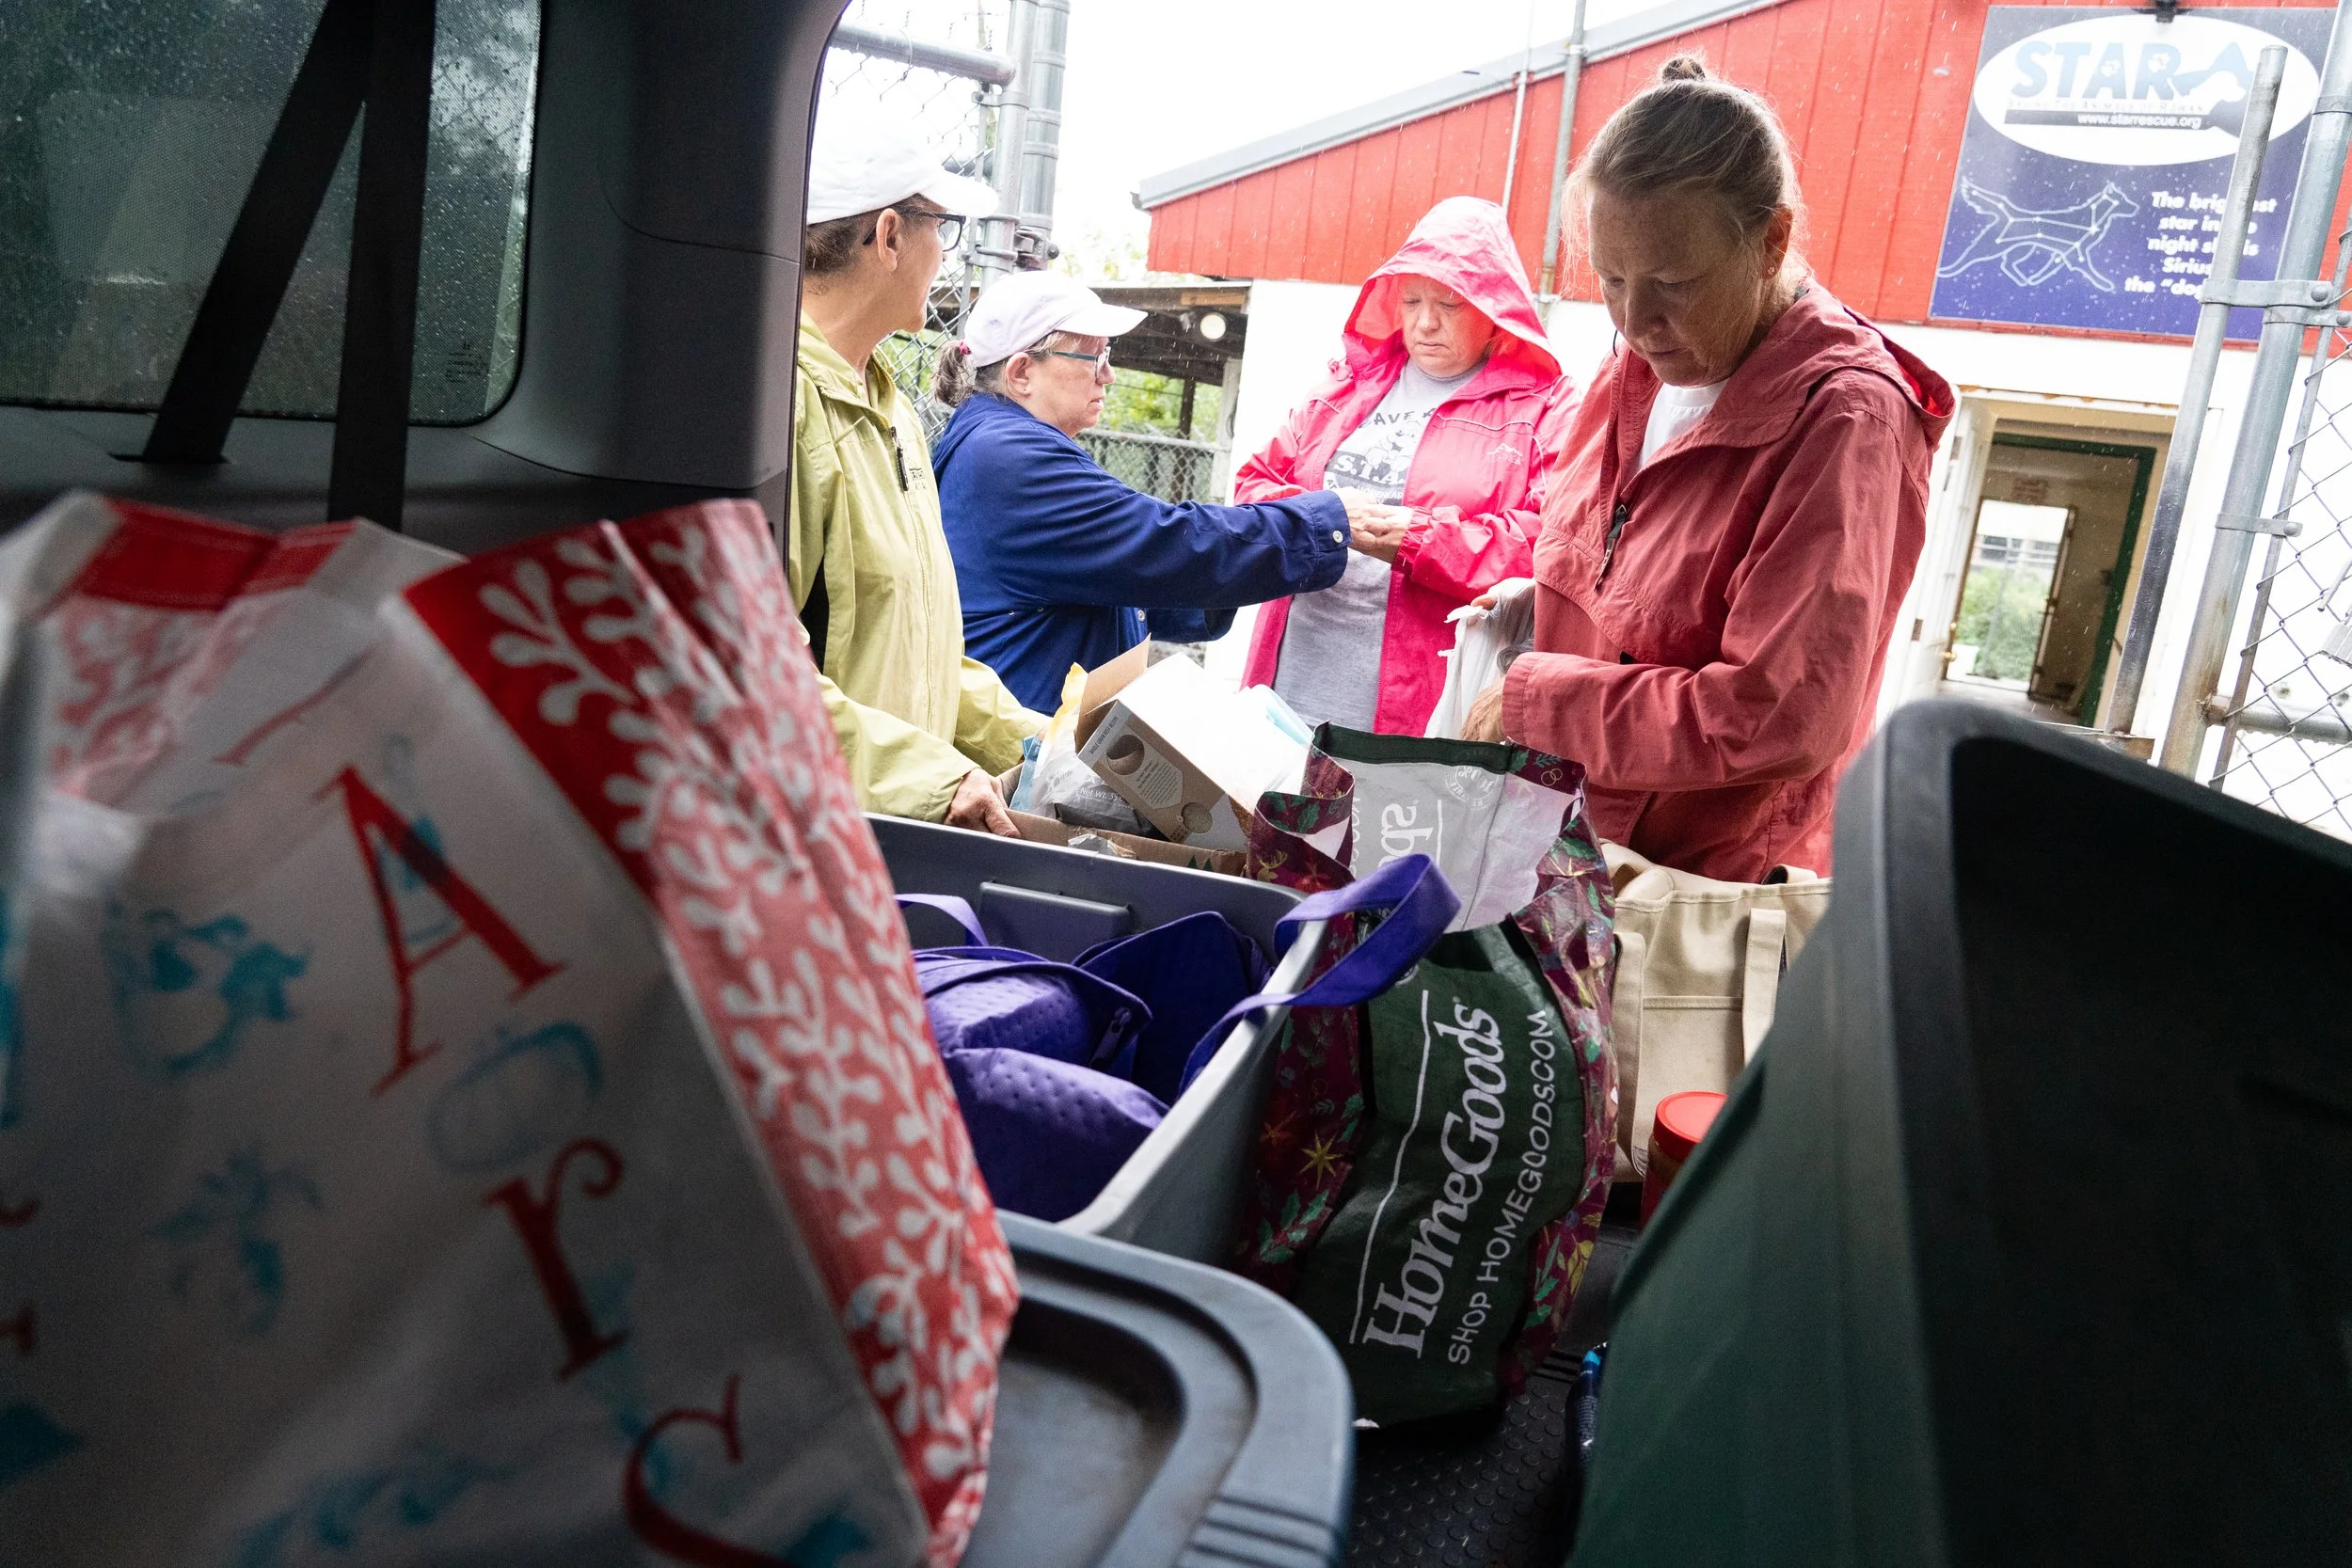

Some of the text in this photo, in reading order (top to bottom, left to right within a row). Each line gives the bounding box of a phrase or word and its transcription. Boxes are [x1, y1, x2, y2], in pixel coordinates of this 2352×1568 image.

[2010, 40, 2181, 101] STAR
[2076, 113, 2202, 130] www.starrescue.org
[2152, 191, 2185, 209] The
[2159, 214, 2221, 232] star in
[2147, 234, 2200, 255] night
[2124, 276, 2156, 293] the
[1359, 411, 1415, 428] AVE
[1362, 1004, 1506, 1358] HomeGoods
[1448, 1010, 1555, 1364] SHOP HOMEGOODS.COM
